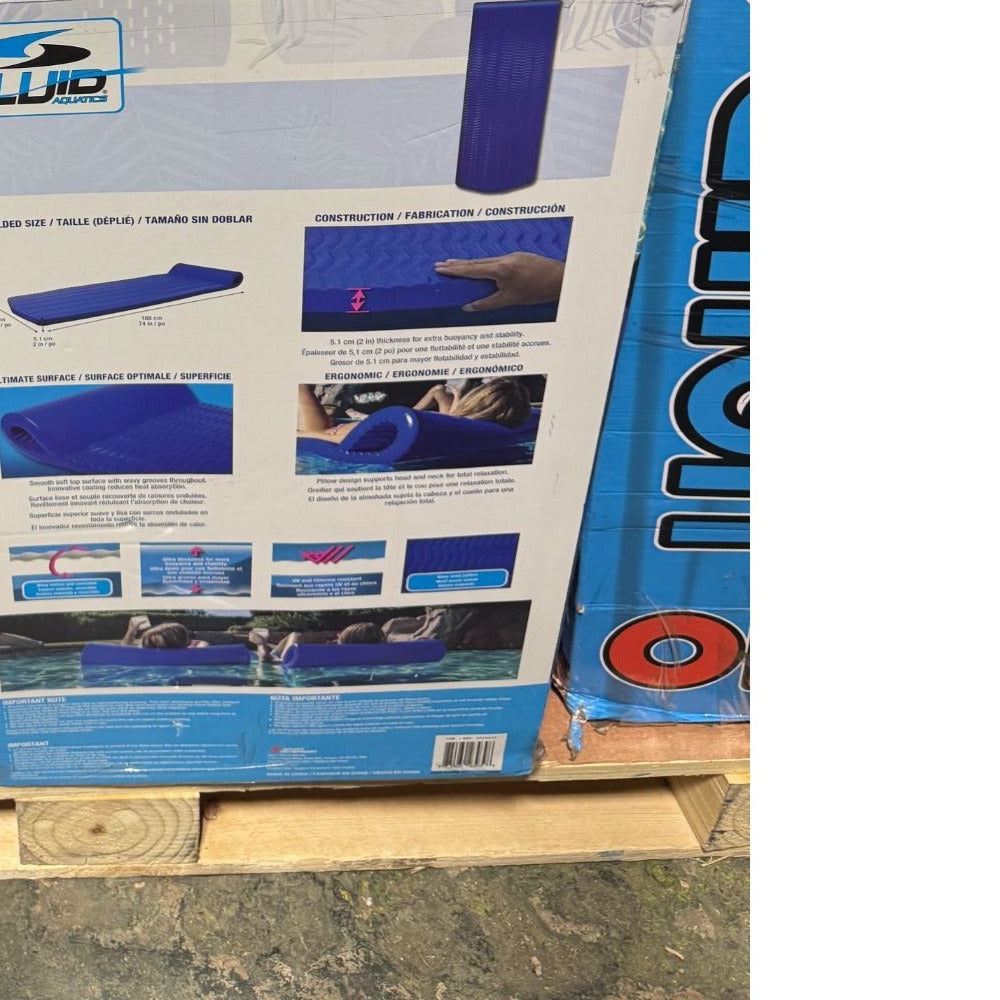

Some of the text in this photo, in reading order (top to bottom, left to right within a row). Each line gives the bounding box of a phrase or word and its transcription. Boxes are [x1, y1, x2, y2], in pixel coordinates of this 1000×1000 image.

[52, 95, 107, 105] AQUATICS
[315, 212, 394, 222] CONSTRUCTION
[405, 208, 474, 220] FABRICATION
[486, 204, 566, 216] CONSTRUCCIÓN
[25, 218, 46, 227] SIZE
[56, 218, 90, 226] TAILLE
[93, 216, 135, 226] (DÉPLIÉ)
[145, 214, 188, 224] TAMAÑO
[192, 216, 209, 224] SIN
[212, 215, 253, 224] DOBLAR
[444, 334, 478, 342] buoyancy
[302, 348, 336, 357] Épaisseur
[392, 368, 449, 378] ERGONOMIE
[460, 364, 524, 374] ERGONÓMICO
